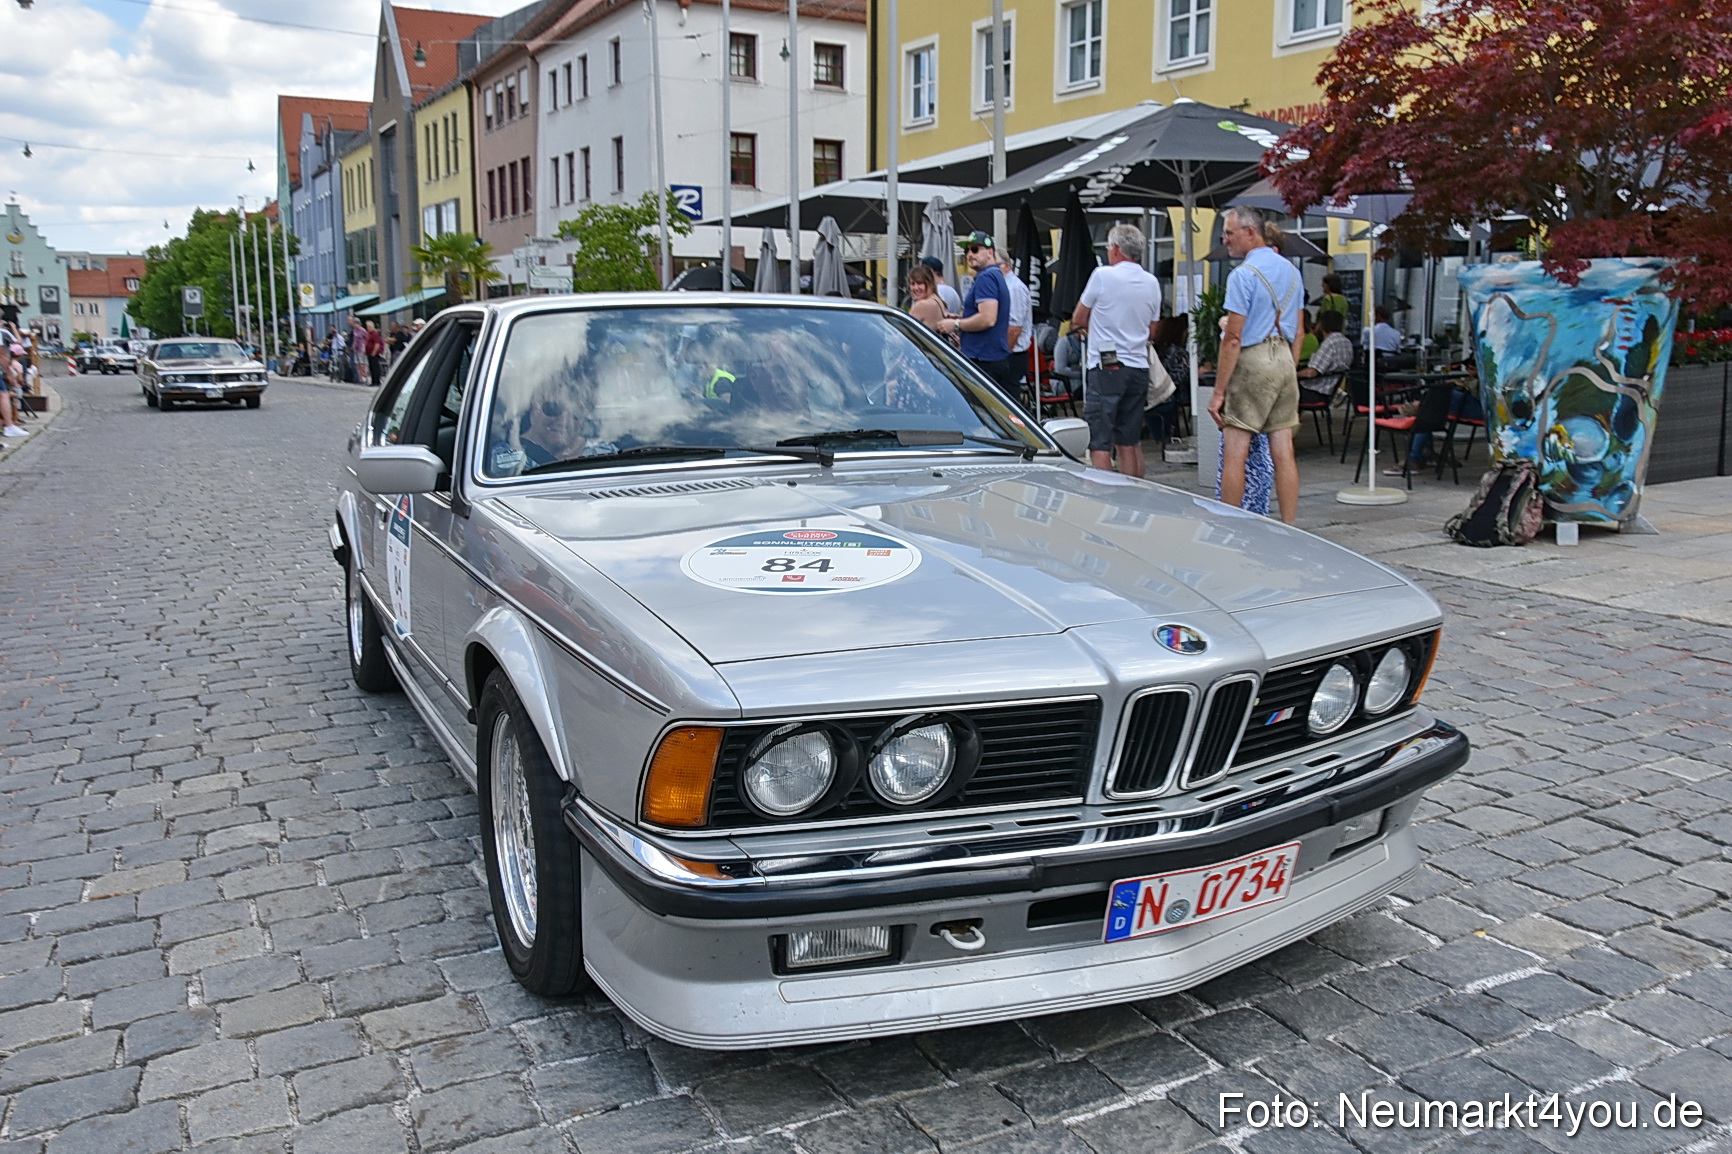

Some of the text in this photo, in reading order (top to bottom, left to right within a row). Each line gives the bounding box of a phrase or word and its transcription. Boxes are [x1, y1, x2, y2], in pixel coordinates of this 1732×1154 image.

[761, 557, 835, 573] 84
[1137, 853, 1288, 929] N 0734
[1114, 916, 1126, 931] D
